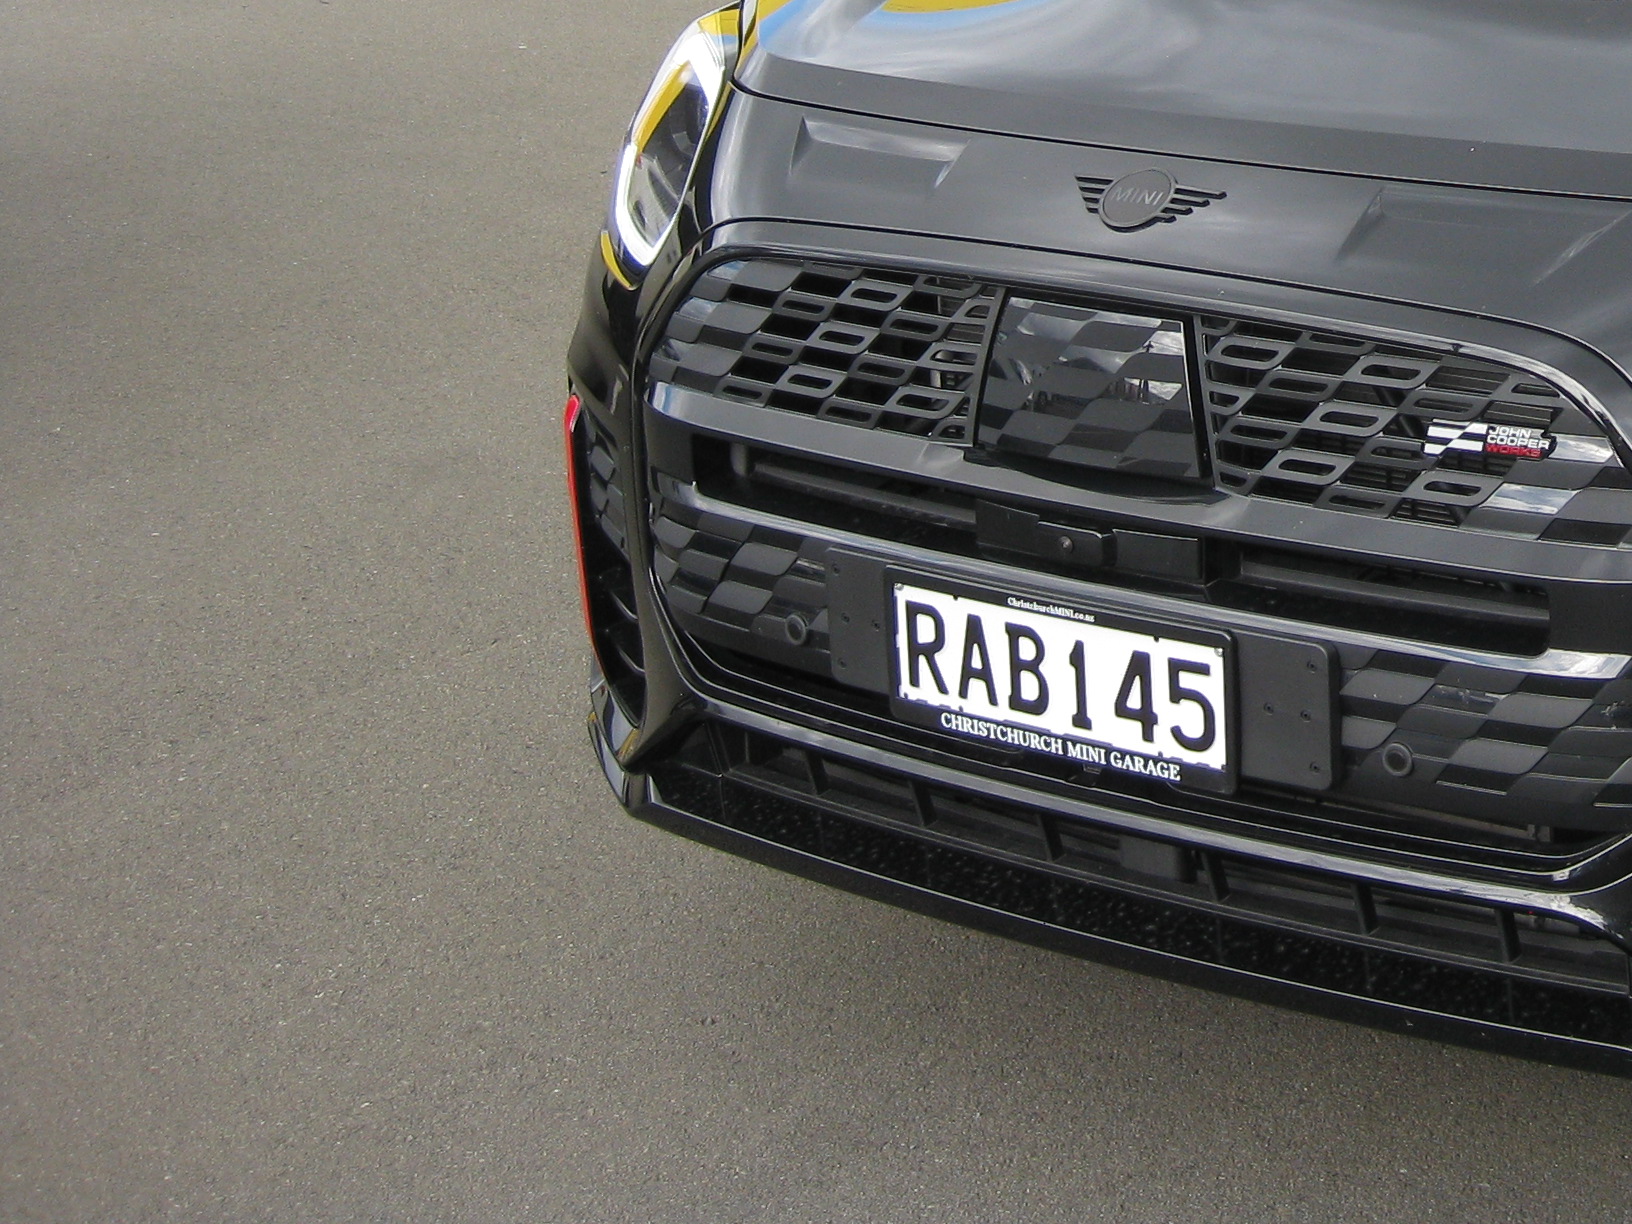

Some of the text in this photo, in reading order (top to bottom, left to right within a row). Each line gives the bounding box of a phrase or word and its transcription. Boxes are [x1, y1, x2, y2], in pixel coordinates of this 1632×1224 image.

[1110, 186, 1164, 206] MINI
[1488, 426, 1531, 438] JOHN
[1486, 435, 1550, 450] COOPER
[1485, 445, 1542, 458] WORKS
[905, 600, 1216, 752] RAB145
[940, 712, 1181, 781] CHRISTCHURCH MINI GARAGE
